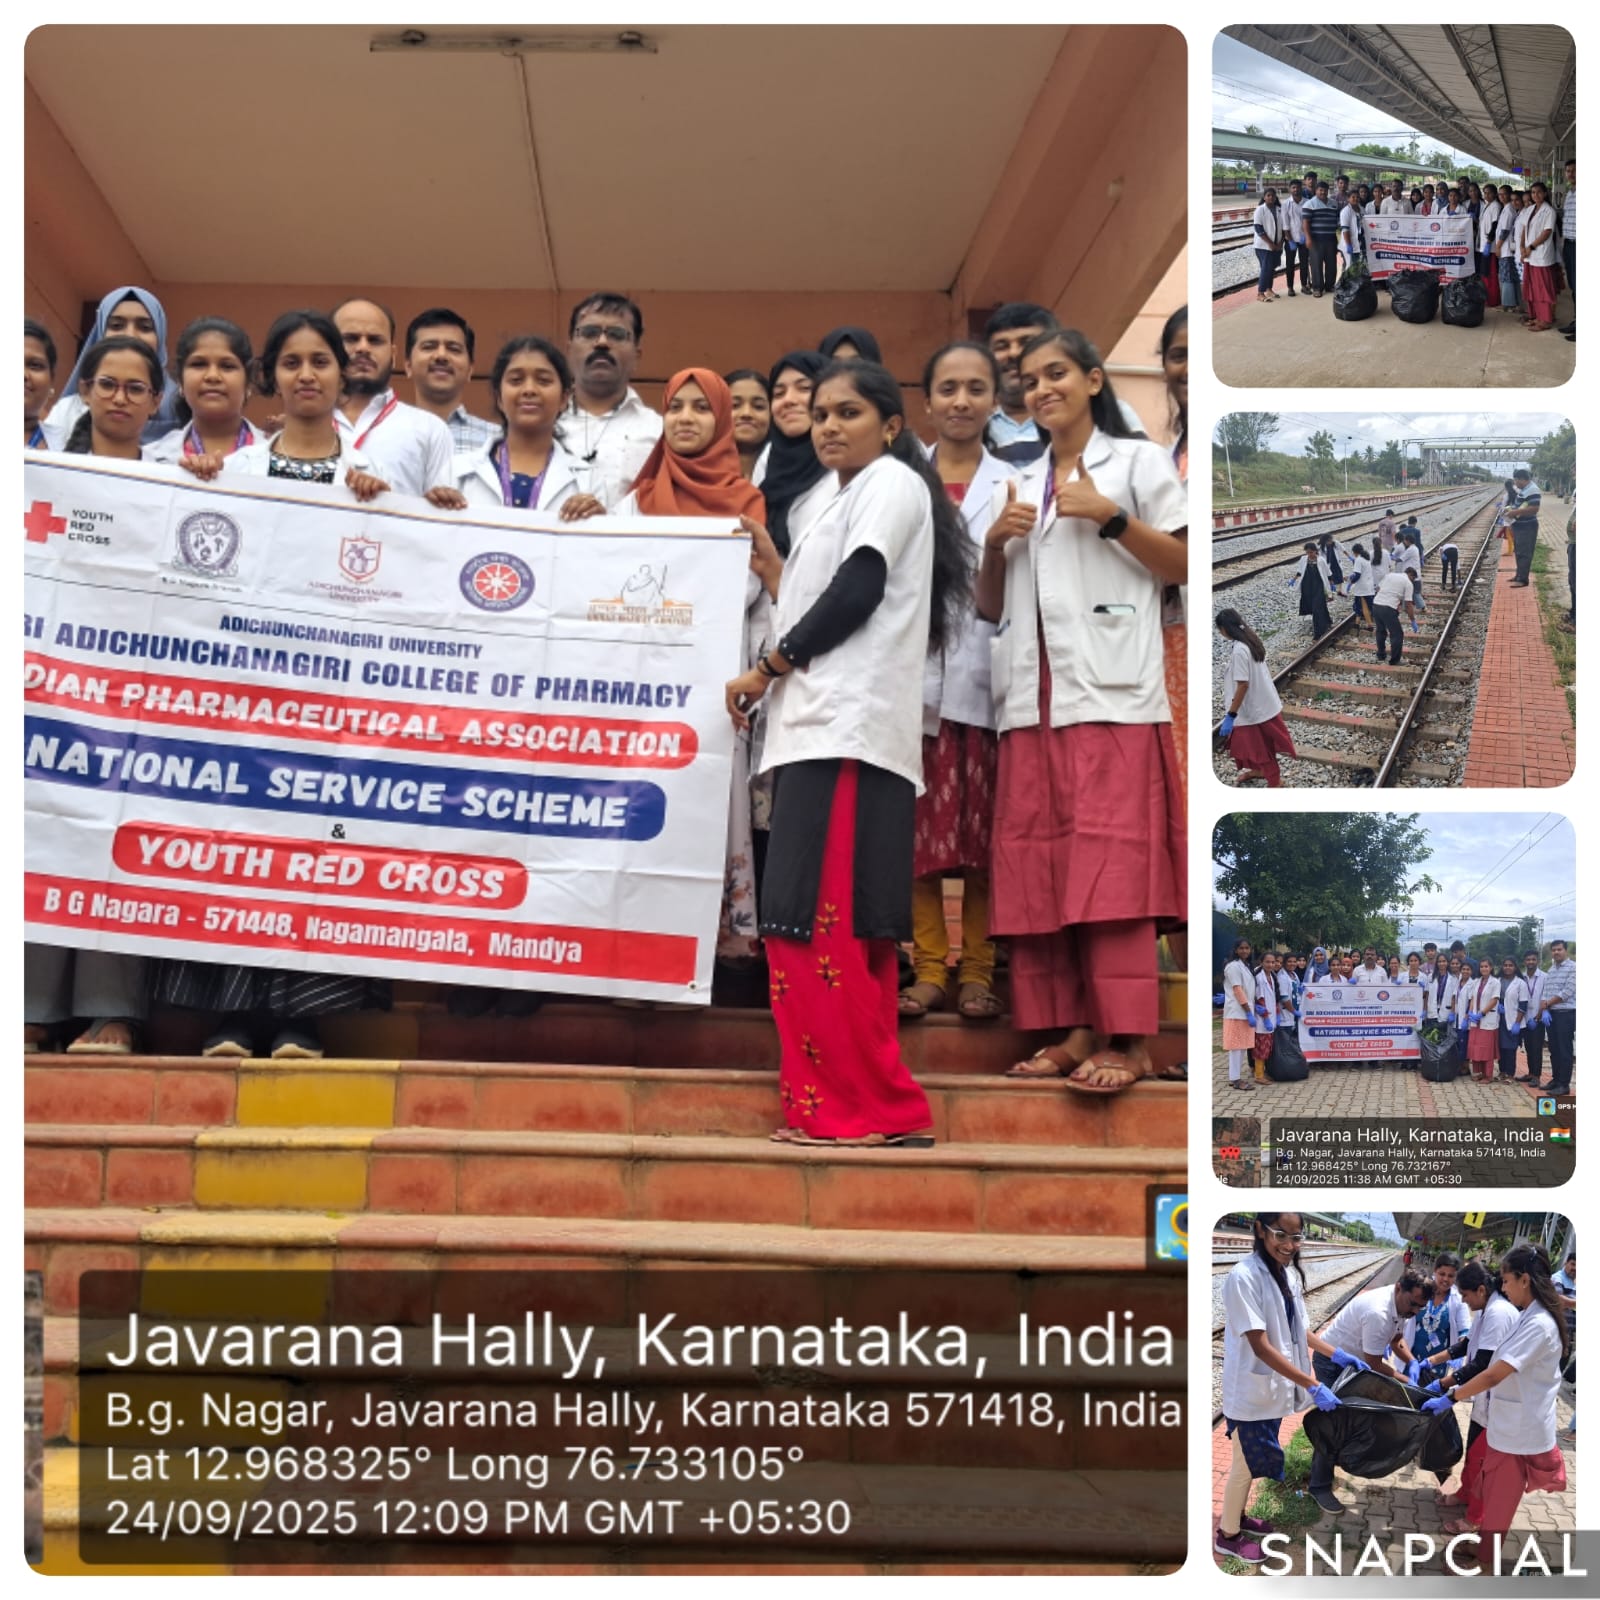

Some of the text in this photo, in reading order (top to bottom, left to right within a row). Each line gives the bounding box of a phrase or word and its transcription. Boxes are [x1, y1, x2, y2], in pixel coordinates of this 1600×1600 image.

[68, 533, 110, 545] CROSS
[70, 520, 94, 532] RED
[72, 509, 113, 523] YOUTH
[219, 615, 483, 659] ADICHUNCHANAGIRI UNIVERSITY
[55, 622, 351, 682] ADICHUNCHANAGIRI
[362, 660, 479, 695] COLLEGE
[491, 674, 525, 698] OF
[535, 677, 692, 708] PHARMACY
[120, 683, 445, 742] PHARMACEUTICAL
[458, 719, 682, 757] ASSOCIATION
[26, 734, 629, 828] NATIONAL SERVICE SCHEME
[331, 824, 346, 839] &
[138, 834, 506, 899] YOUTH RED CROSS
[44, 888, 60, 912] B
[68, 891, 83, 915] G
[91, 893, 180, 927] Nagara
[204, 907, 297, 941] 571448,
[305, 917, 475, 956] Nagamangala,
[488, 932, 582, 964] Mandya
